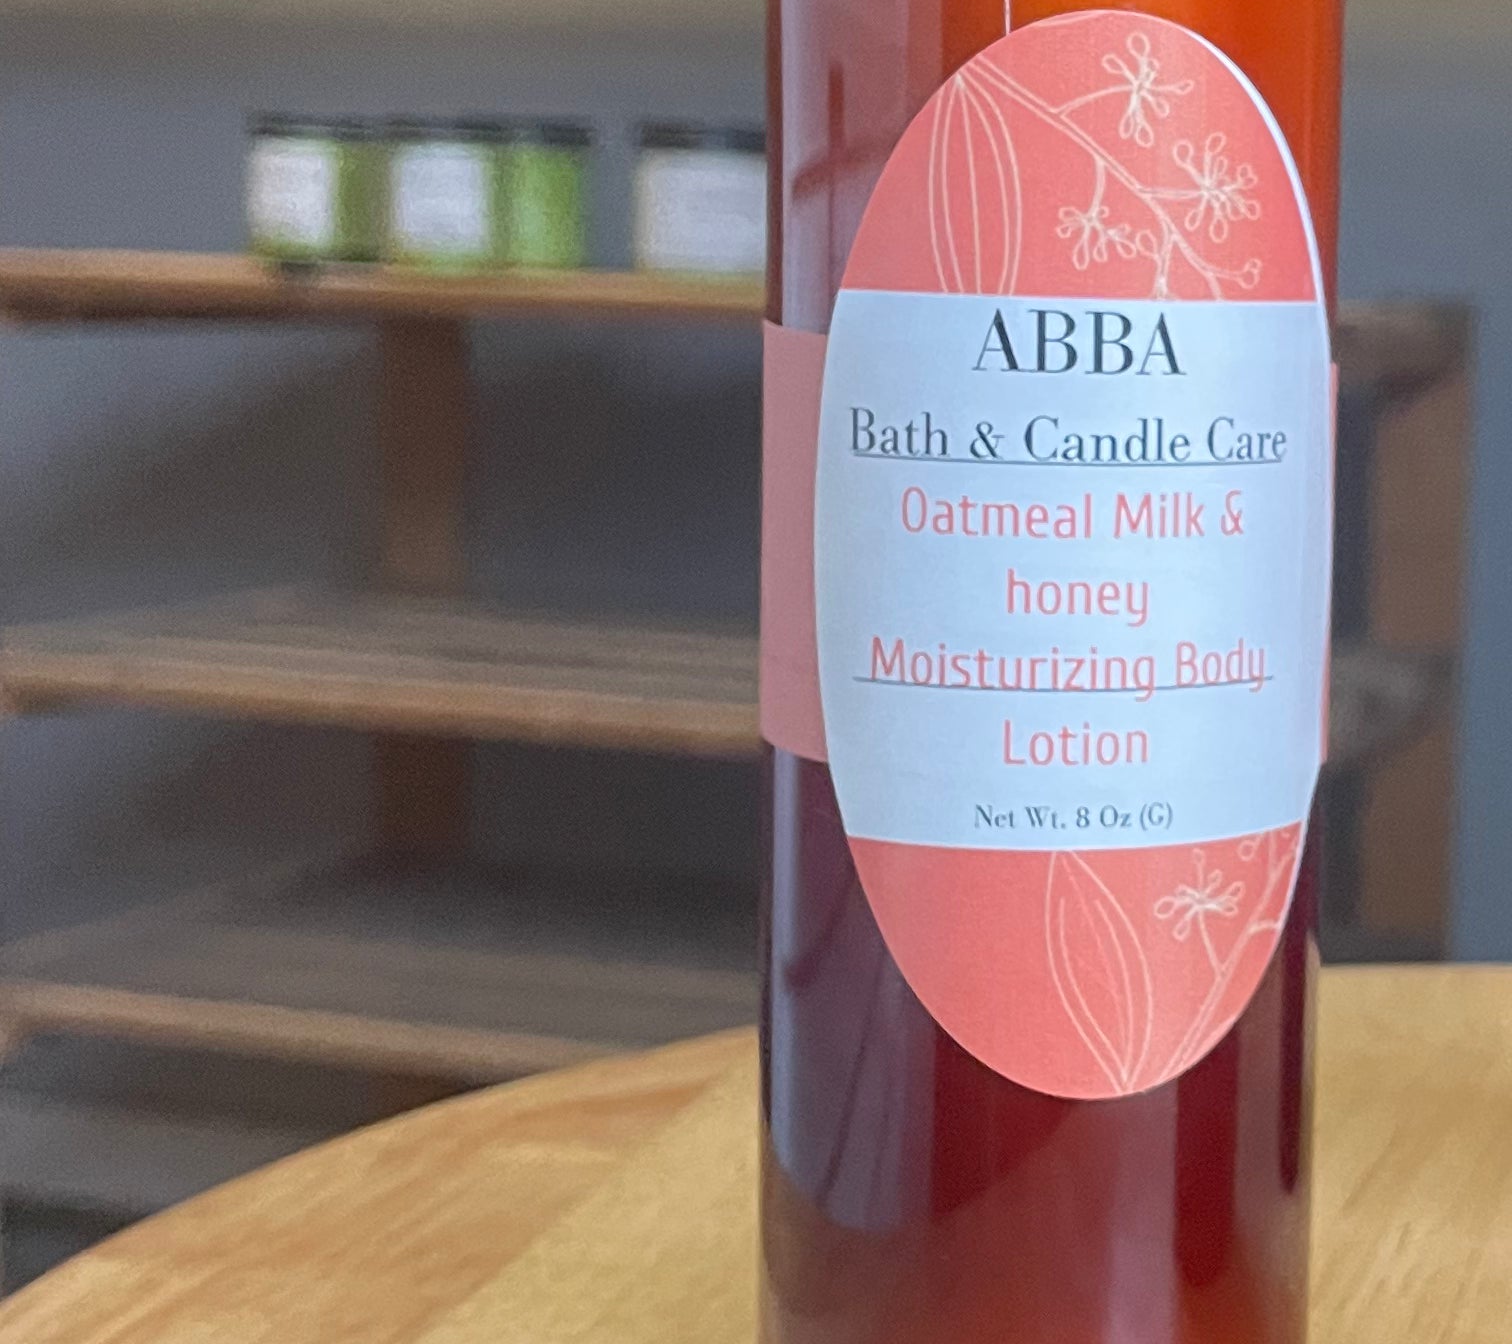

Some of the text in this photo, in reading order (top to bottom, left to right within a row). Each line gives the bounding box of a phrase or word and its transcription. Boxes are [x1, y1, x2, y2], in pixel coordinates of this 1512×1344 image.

[972, 308, 1187, 376] ABBA
[850, 406, 1287, 463] Bath & Candle Care
[900, 486, 1244, 539] Oatmeal Milk &
[1006, 568, 1149, 627] honey
[870, 636, 1266, 702] Moisturizing Body
[1003, 718, 1148, 766] Lotion
[974, 801, 1174, 831] Net Wt. 8 Oz (G)
